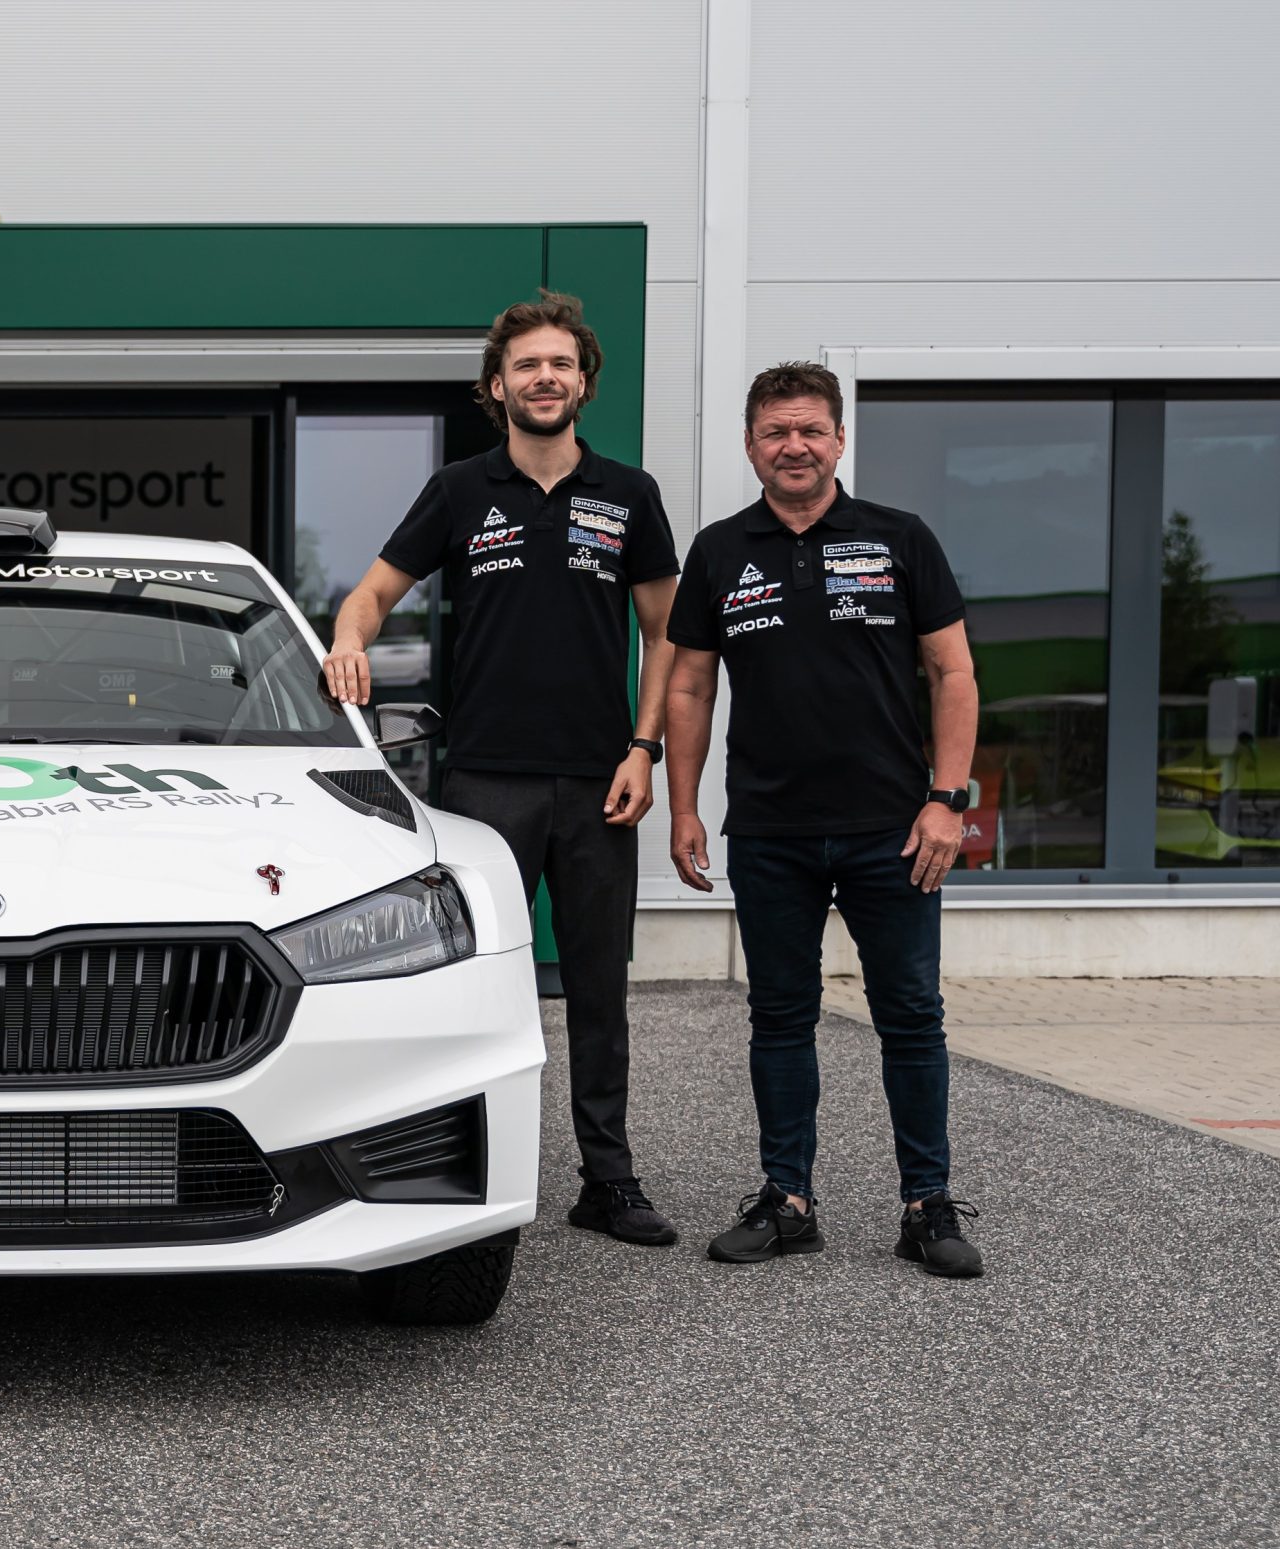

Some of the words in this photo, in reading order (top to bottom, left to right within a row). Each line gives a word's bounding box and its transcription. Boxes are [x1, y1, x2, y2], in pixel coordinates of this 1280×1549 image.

[483, 516, 508, 528] PEAK
[739, 572, 765, 586] PEAK
[744, 601, 760, 609] Team
[12, 669, 38, 680] OMP
[210, 666, 235, 678] OMP
[99, 673, 136, 688] OMP
[85, 791, 155, 813] RS
[157, 790, 297, 812] Rally2
